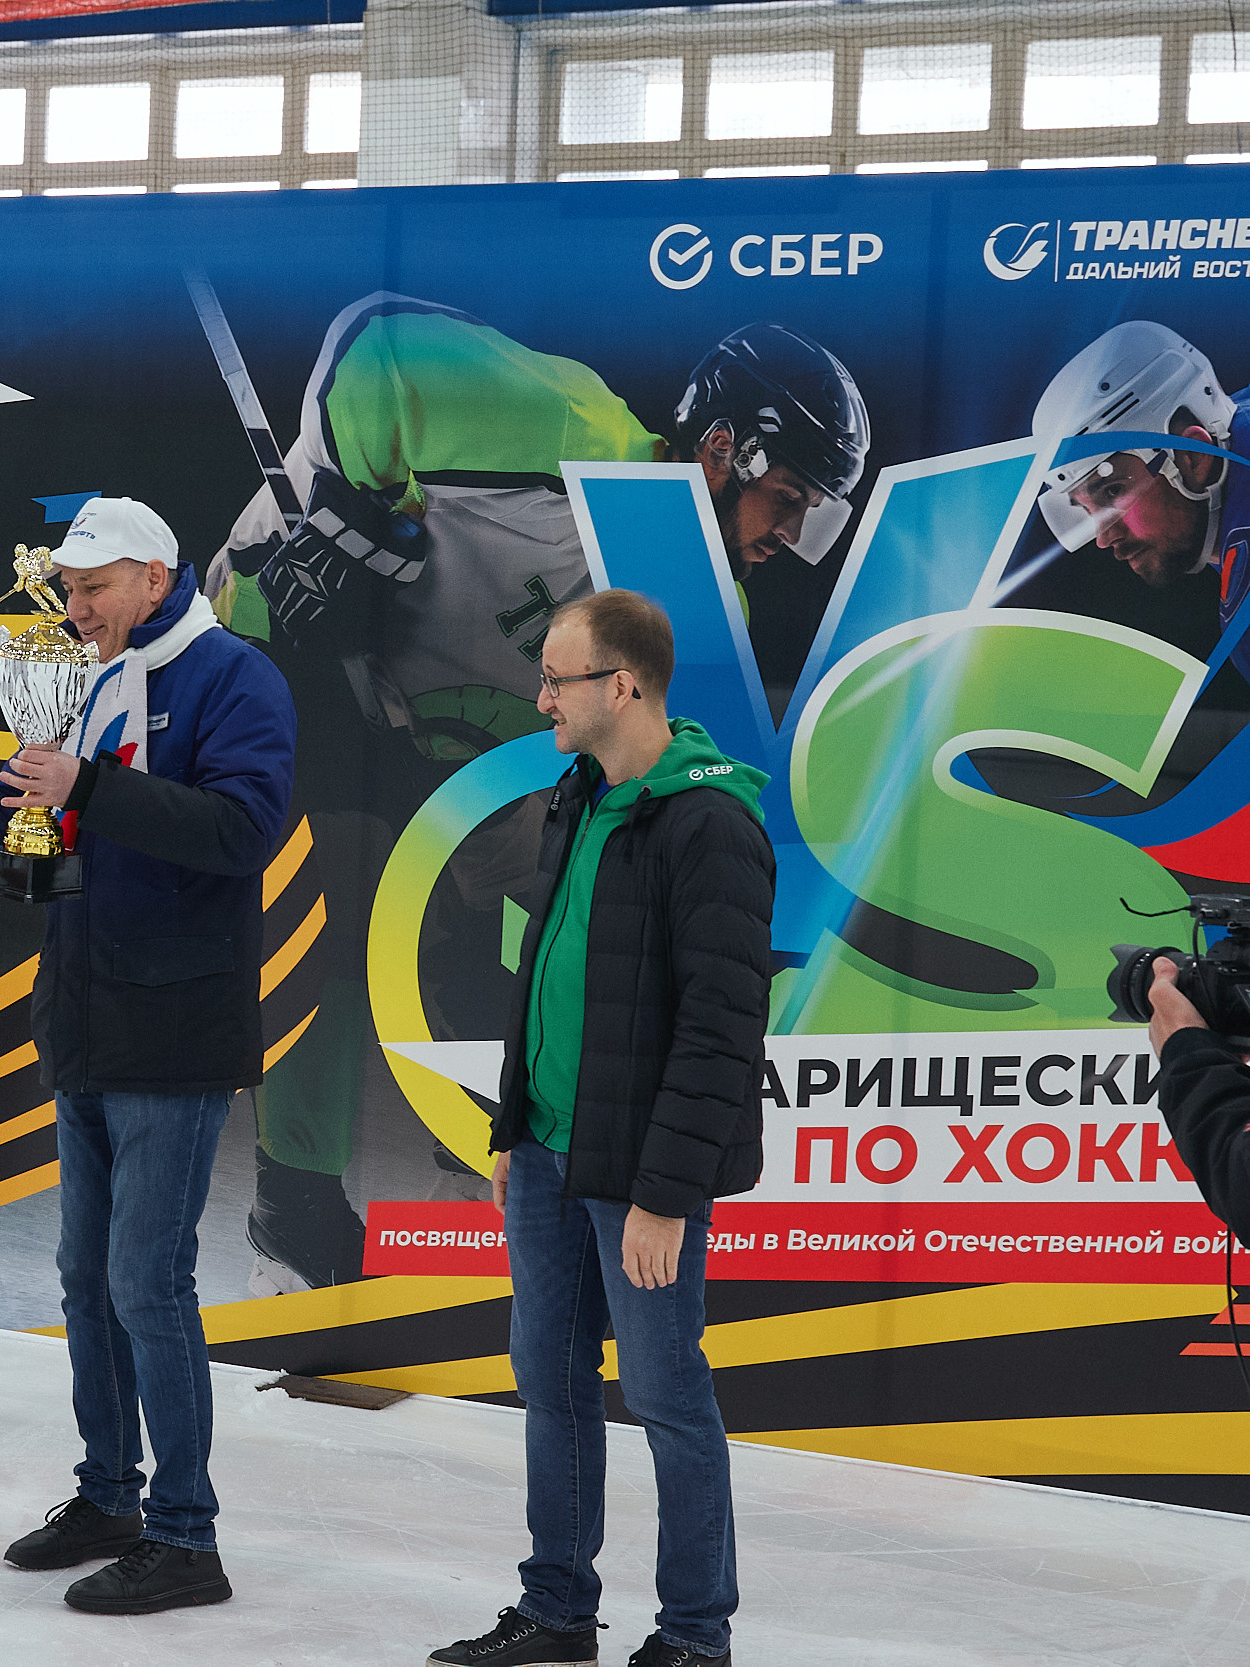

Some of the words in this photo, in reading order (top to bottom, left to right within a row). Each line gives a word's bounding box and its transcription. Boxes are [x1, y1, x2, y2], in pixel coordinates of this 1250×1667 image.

[730, 233, 884, 276] СБЕР
[1066, 255, 1181, 280] ДАЛЬНИЙ
[705, 765, 733, 776] СБЕР
[794, 1125, 918, 1184] ПО
[762, 1233, 779, 1250] в
[786, 1228, 916, 1252] Великой
[924, 1230, 1163, 1253] Отечественной
